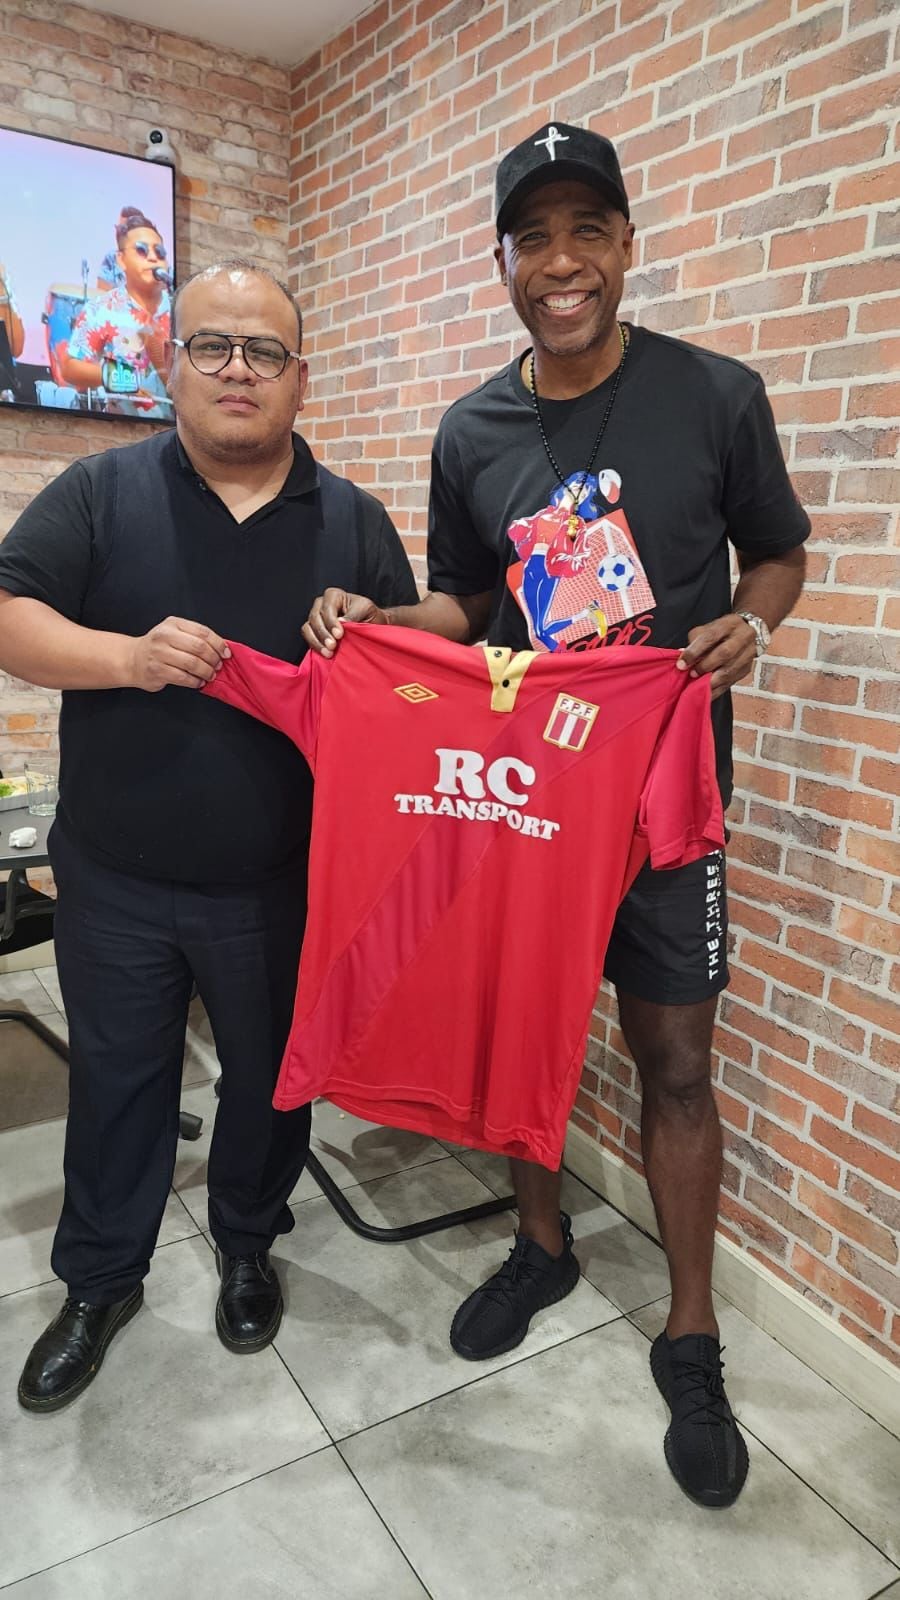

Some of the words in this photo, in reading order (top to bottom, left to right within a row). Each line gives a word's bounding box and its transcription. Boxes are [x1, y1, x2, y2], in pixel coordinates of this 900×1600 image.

[434, 748, 536, 806] RC
[394, 793, 560, 840] TRANSPORT
[706, 865, 719, 933] THREE
[707, 938, 720, 980] THE
